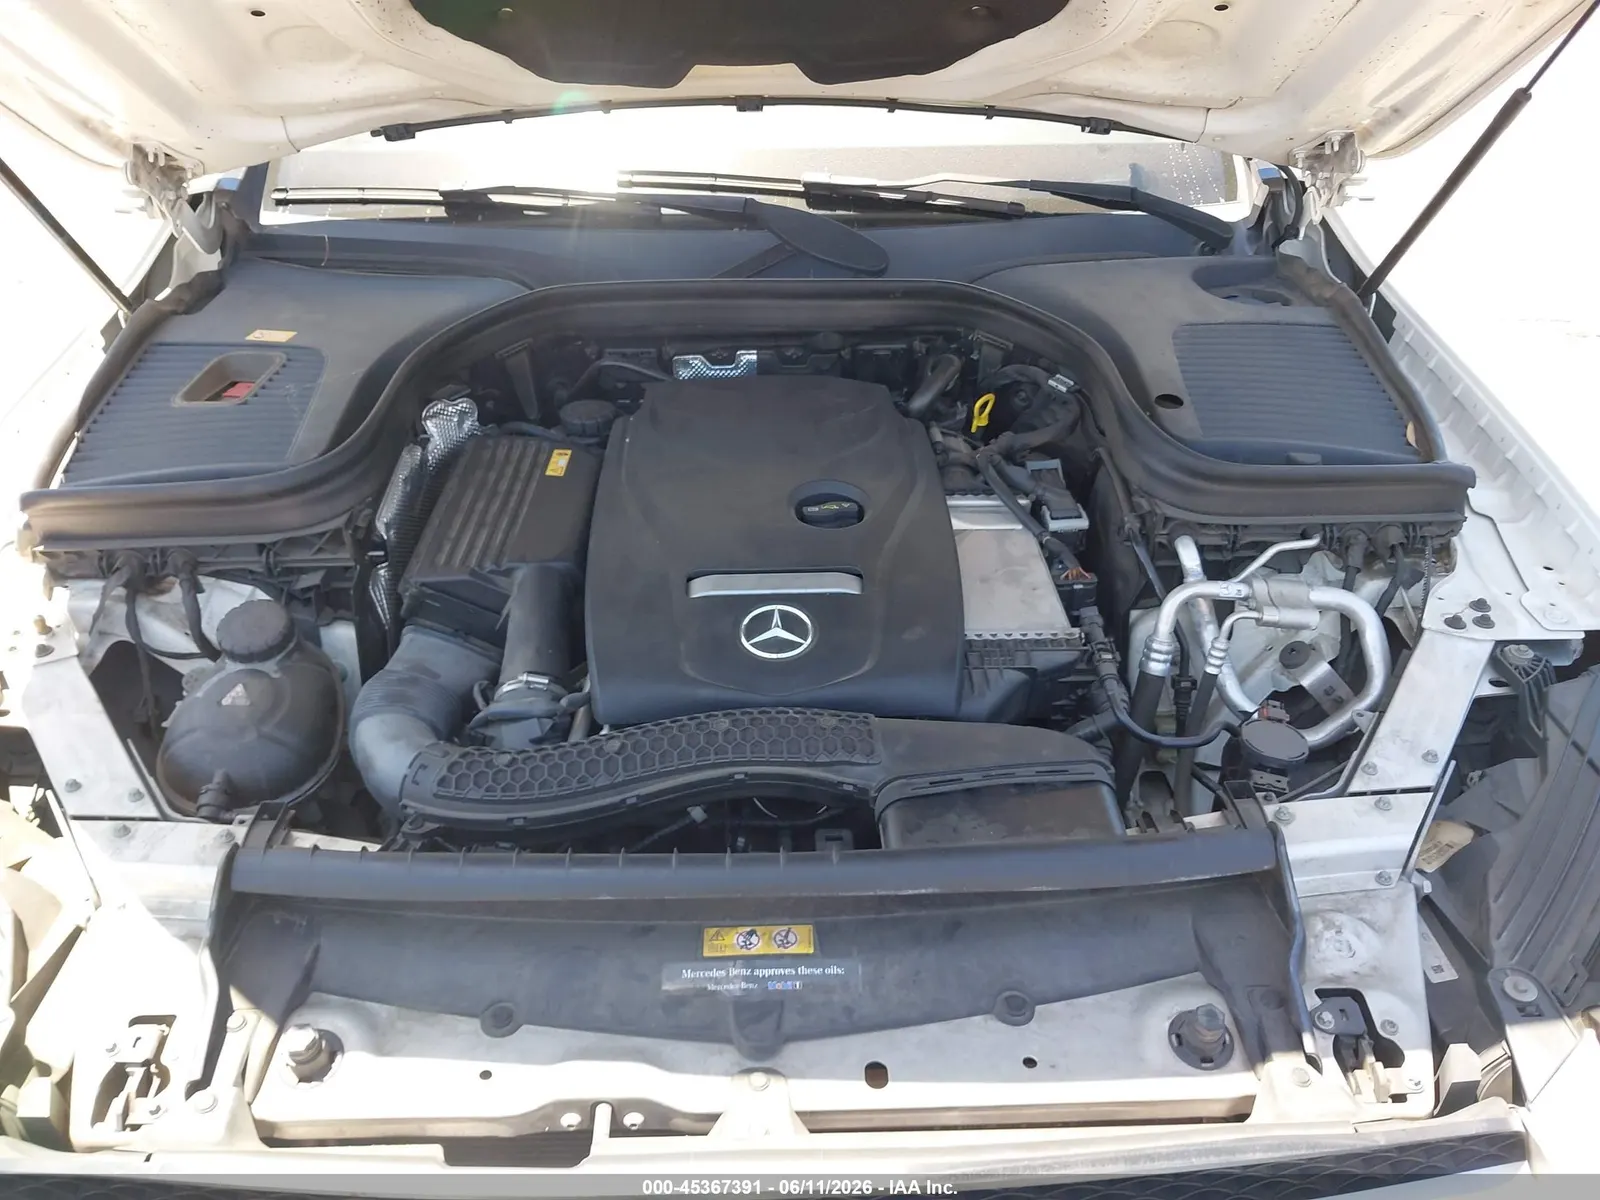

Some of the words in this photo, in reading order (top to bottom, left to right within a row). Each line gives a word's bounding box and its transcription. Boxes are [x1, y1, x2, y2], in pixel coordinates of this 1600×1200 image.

[681, 968, 726, 979] Mercedes
[753, 967, 796, 978] approves
[797, 965, 823, 975] these
[824, 965, 845, 975] oils:
